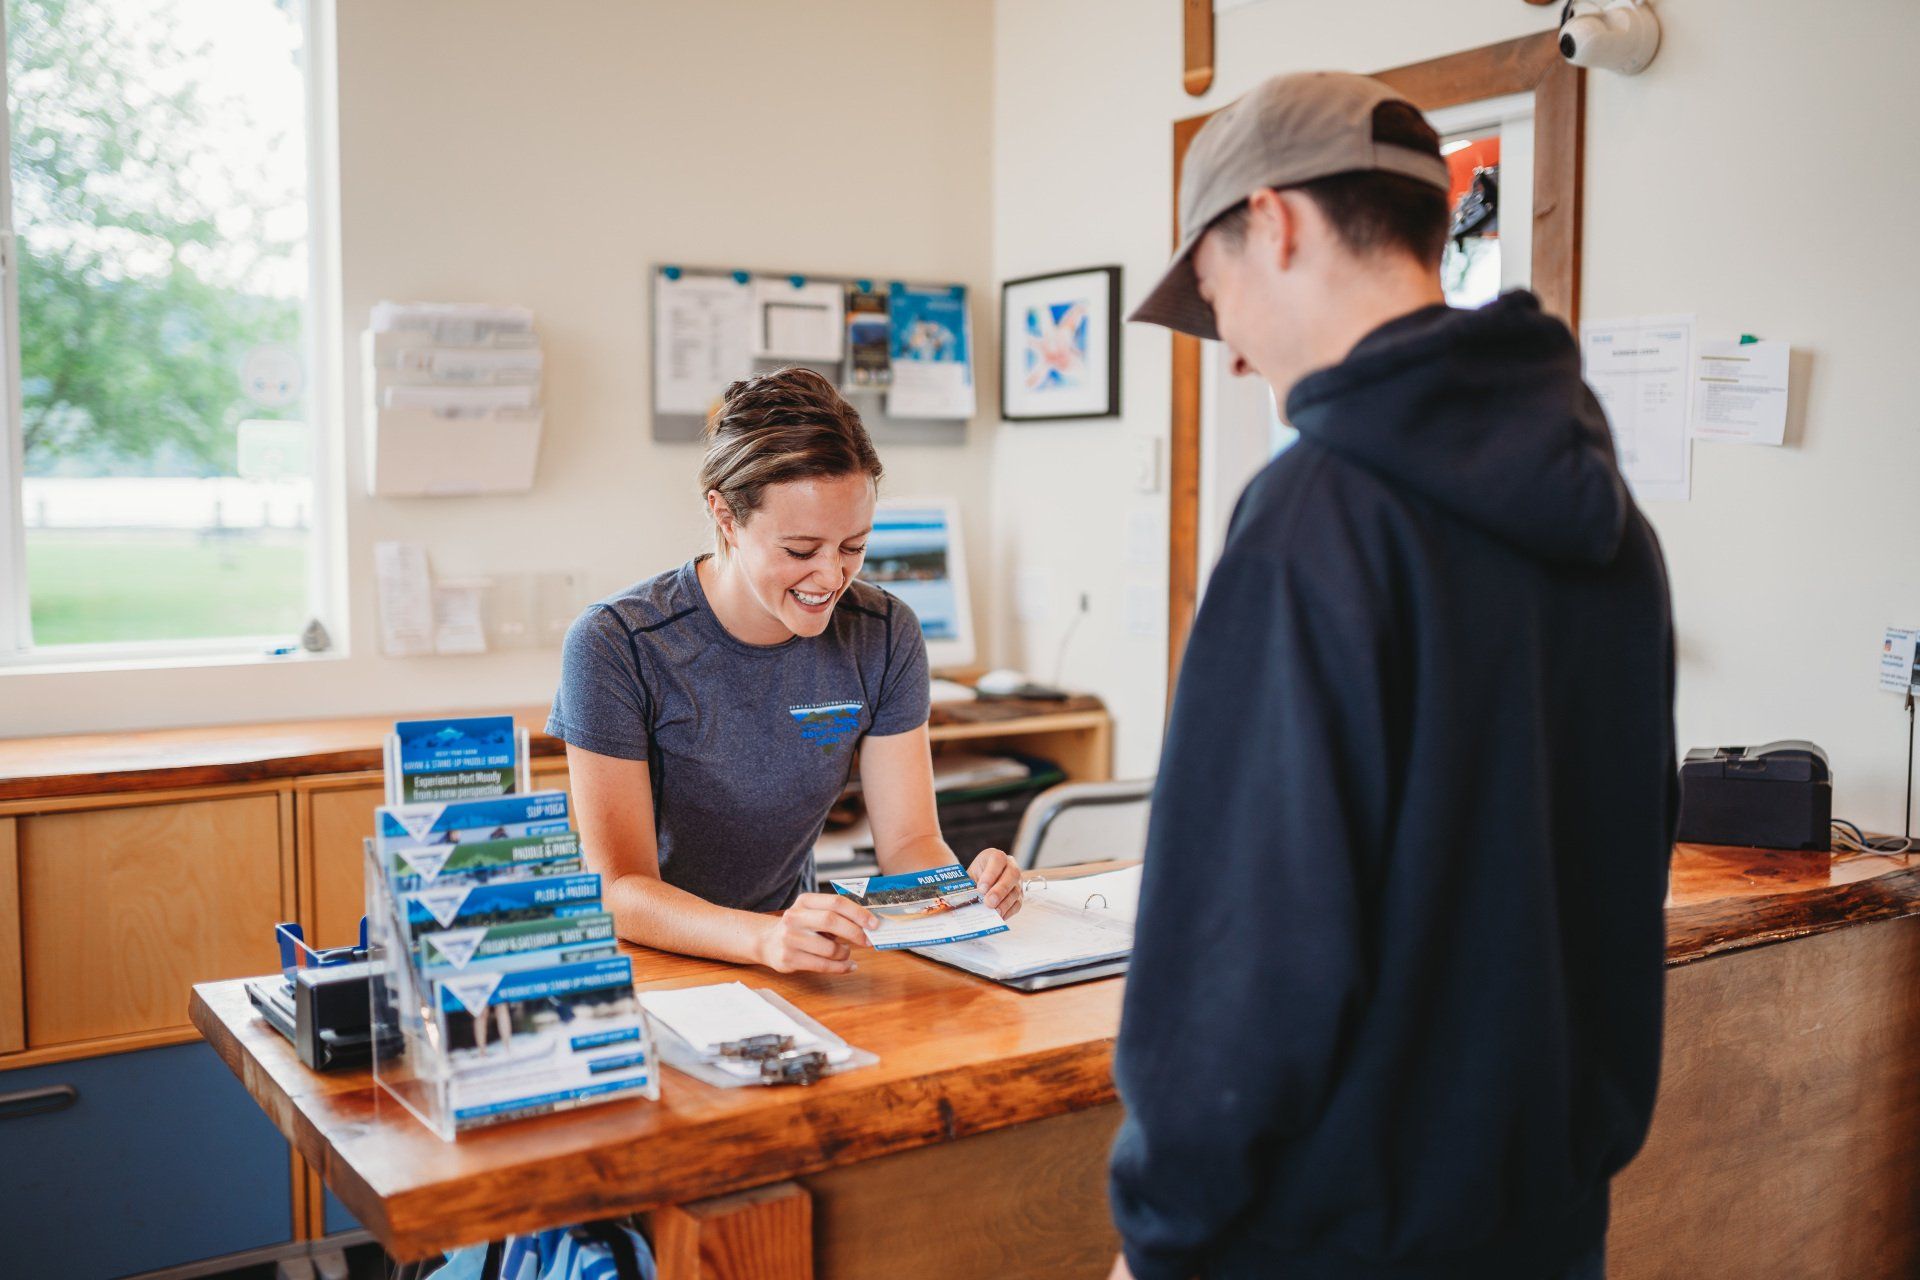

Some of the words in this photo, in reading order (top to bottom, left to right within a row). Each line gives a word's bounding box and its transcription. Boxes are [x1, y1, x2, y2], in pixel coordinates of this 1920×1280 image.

[414, 775, 457, 789] Experience
[459, 773, 474, 785] Port
[475, 770, 501, 784] Moody
[413, 789, 432, 801] from
[440, 789, 456, 799] new
[526, 806, 543, 819] SUP
[513, 845, 543, 861] PADDLE
[544, 844, 552, 857] &
[917, 875, 936, 885] PLOD
[934, 873, 942, 882] &
[940, 869, 965, 881] PADDLE
[565, 885, 596, 899] PADDLE
